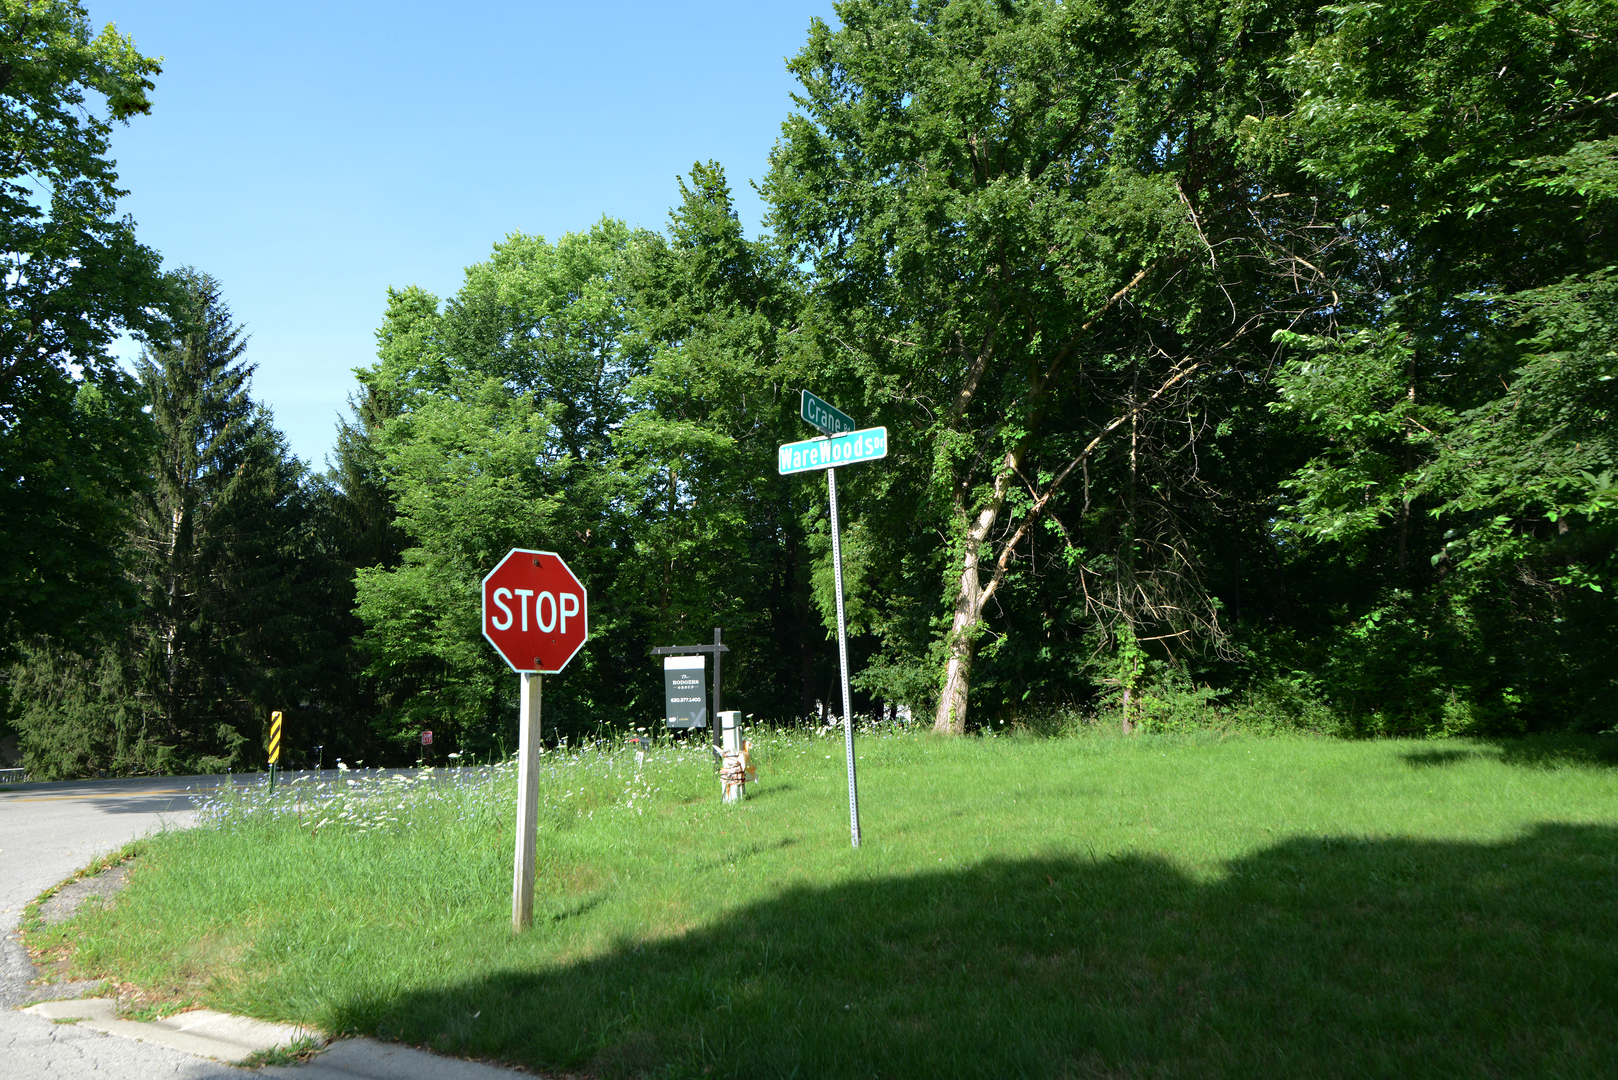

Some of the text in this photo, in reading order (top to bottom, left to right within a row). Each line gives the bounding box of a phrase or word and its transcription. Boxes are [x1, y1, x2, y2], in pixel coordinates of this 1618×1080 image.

[808, 398, 841, 433] Crane
[874, 437, 885, 448] Dr
[492, 587, 580, 634] STOP
